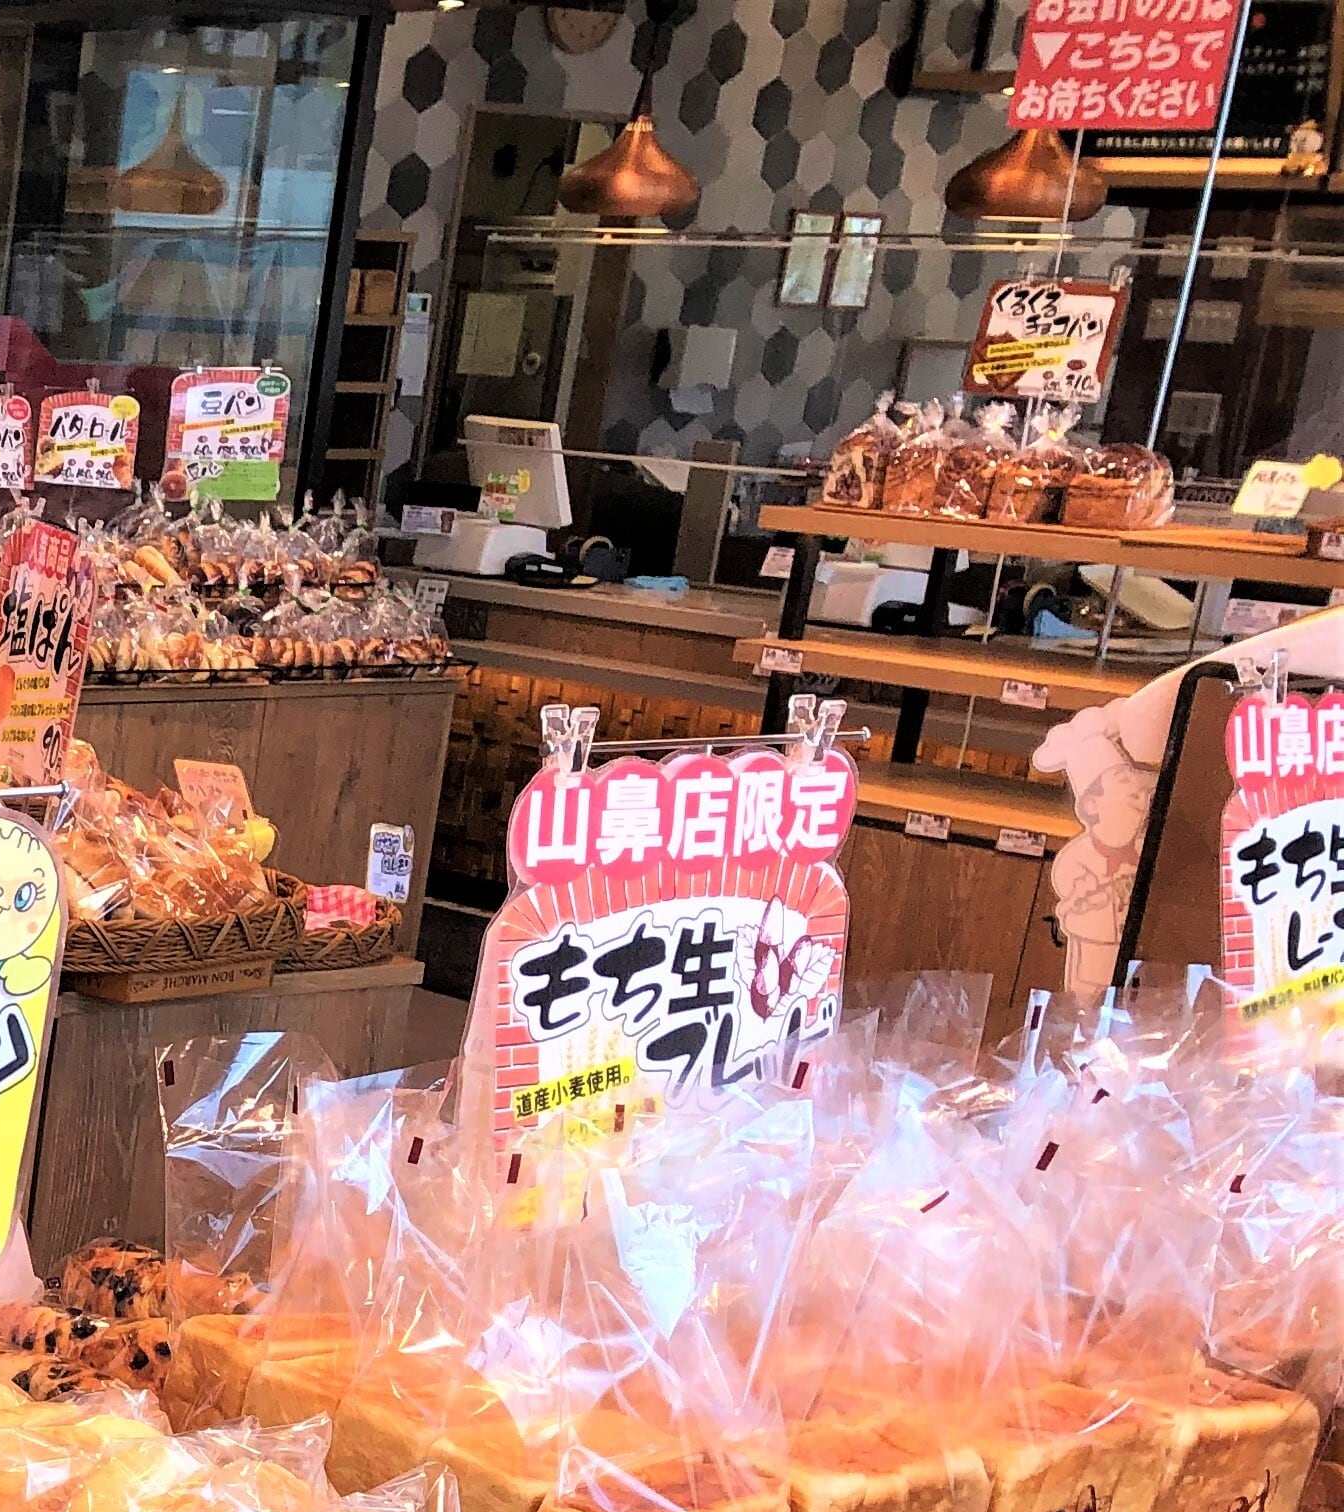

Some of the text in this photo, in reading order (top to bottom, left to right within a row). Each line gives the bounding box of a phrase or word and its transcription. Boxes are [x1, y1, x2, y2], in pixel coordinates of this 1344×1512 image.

[1069, 29, 1225, 71] こちらで
[1016, 78, 1214, 122] お待ちください
[1026, 312, 1104, 338] チョコパン
[200, 391, 262, 415] 豆パン
[50, 412, 130, 443] バターロール
[525, 769, 849, 868] 山鼻店限定
[1287, 908, 1344, 972] レー
[519, 921, 735, 1032] もち生
[515, 1064, 631, 1119] 道産小麦使用。
